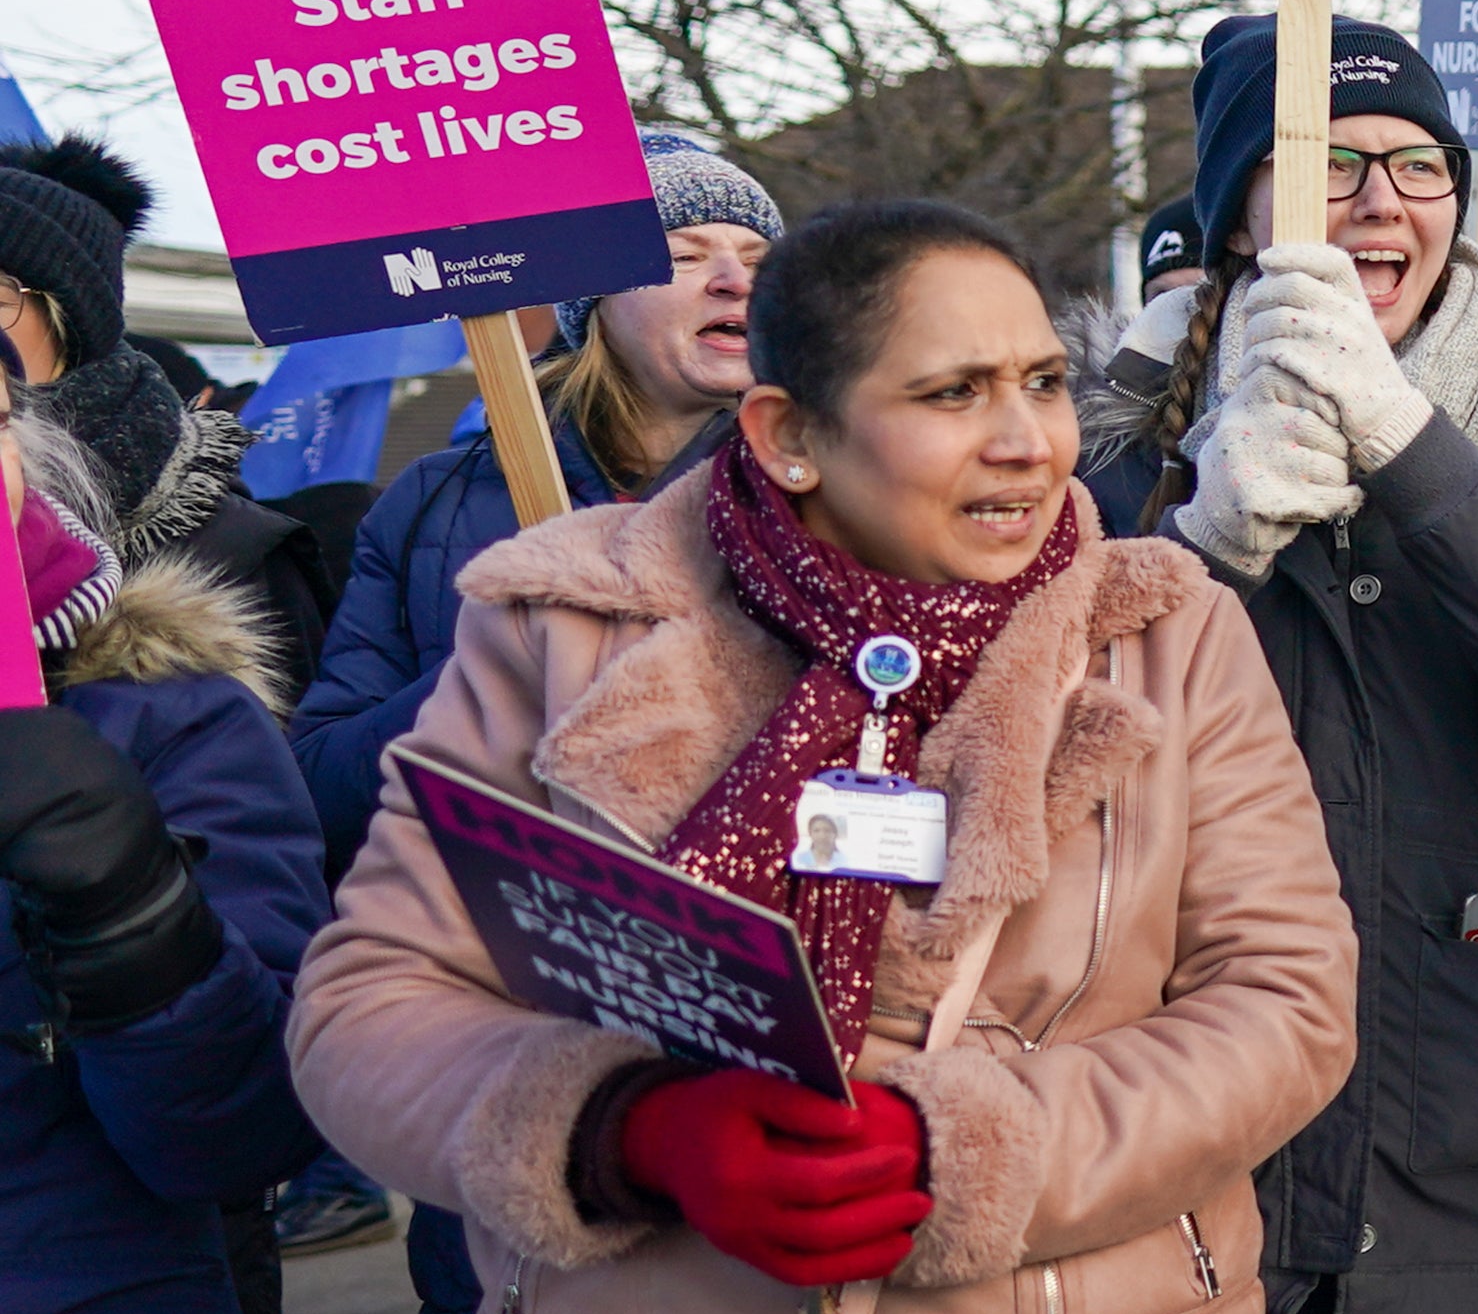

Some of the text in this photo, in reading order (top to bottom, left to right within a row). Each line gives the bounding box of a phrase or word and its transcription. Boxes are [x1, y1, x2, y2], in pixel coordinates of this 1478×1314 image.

[221, 33, 577, 112] shortages
[1341, 70, 1391, 84] Nursing
[257, 101, 584, 180] cost lives
[443, 250, 526, 277] Royal College
[447, 266, 512, 287] of Nursing
[511, 907, 654, 982] FAIR
[592, 898, 719, 969] YOU
